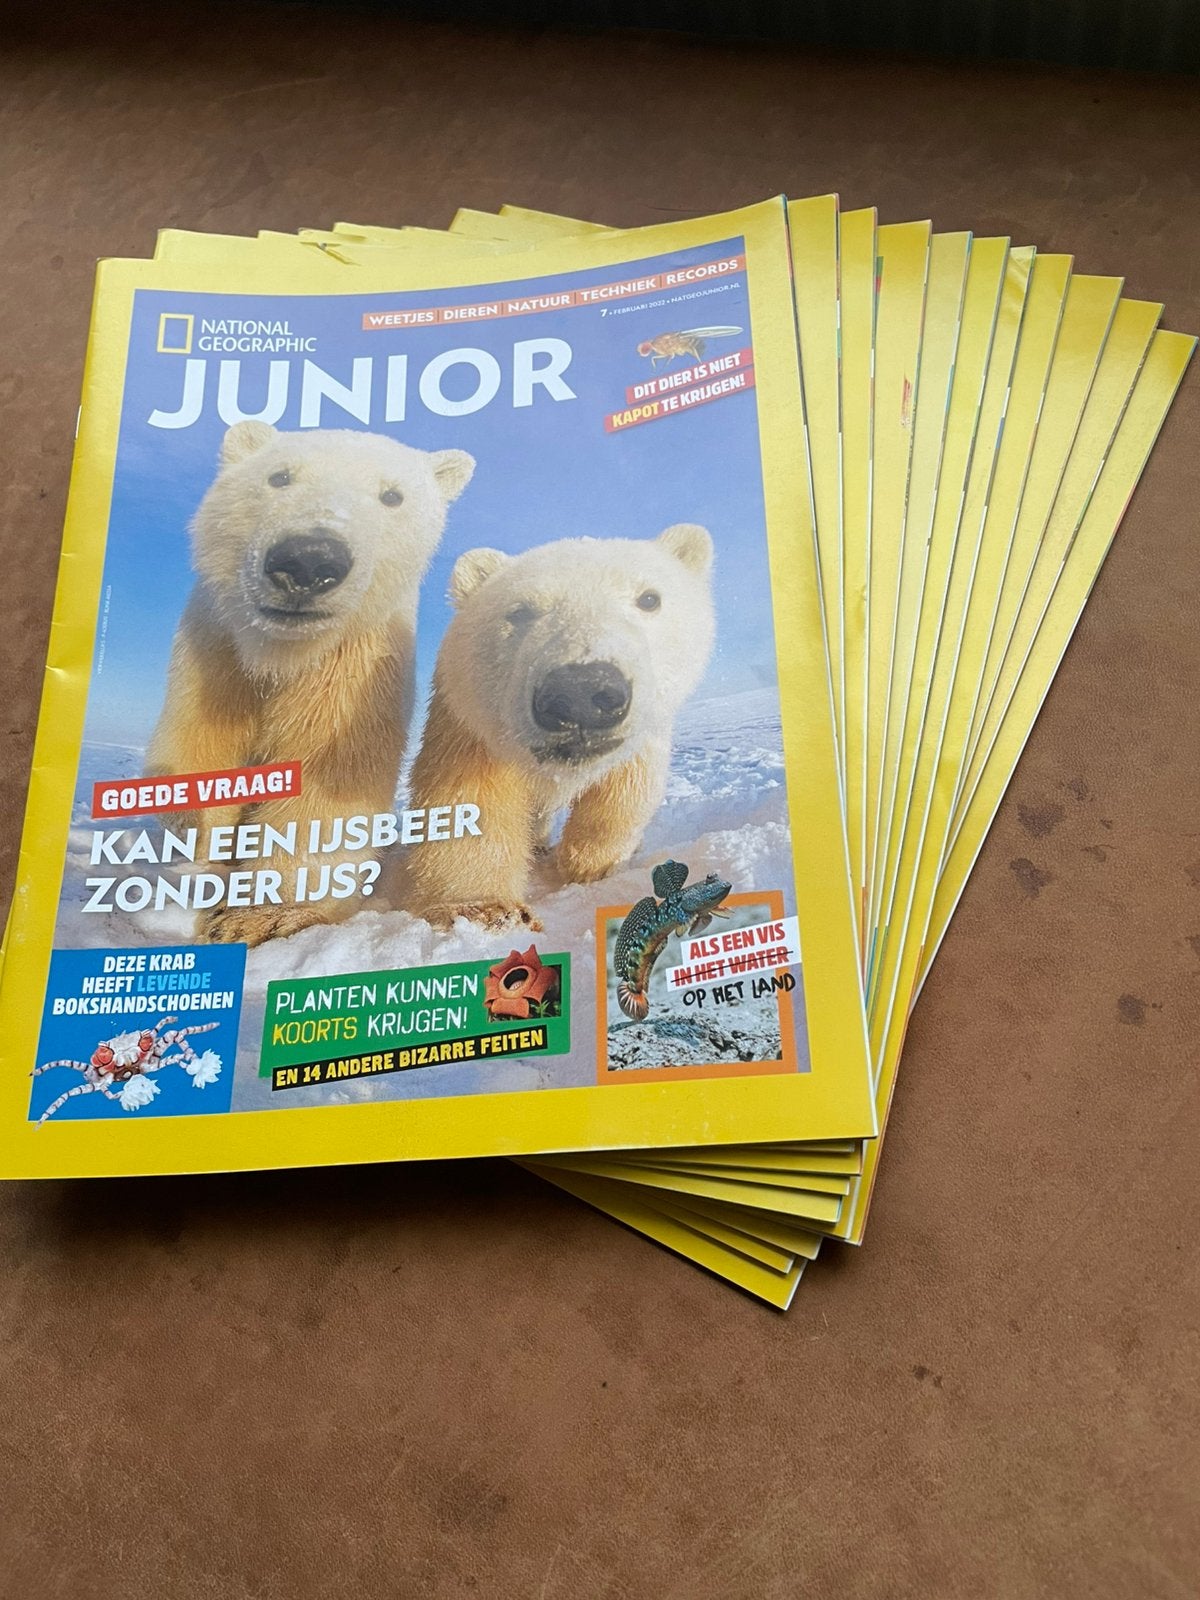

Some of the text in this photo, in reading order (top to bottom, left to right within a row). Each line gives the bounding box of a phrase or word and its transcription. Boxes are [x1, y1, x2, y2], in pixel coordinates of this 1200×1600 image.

[369, 259, 738, 326] WEETJES DIEREN NATUUR TECHNIEK RECORDS
[600, 282, 740, 317] 7 FEBRUARI 2022 NATGEOJUNIOR.NL
[198, 336, 317, 352] GEOGRAPHIC
[200, 319, 293, 336] NATIONAL
[147, 337, 578, 430] JUNIOR
[634, 353, 741, 399] DIT DIER IS NIET
[612, 373, 746, 427] KAPOT TE KRIJGEN!
[102, 769, 294, 811] GOEDE VRAAG!
[89, 803, 482, 866] KAN EEN IJSBEER
[81, 860, 381, 913] ZONDER IJS?
[689, 922, 786, 960] ALS EEN VIS
[82, 972, 212, 994] HEEFT LEVENDE
[103, 953, 196, 973] DEZE KRAB
[673, 946, 790, 987] IN HET WATER
[52, 991, 235, 1016] BOKSHANDSCHOENEN
[275, 973, 478, 1015] PLANTEN KUNNEN
[682, 973, 796, 1008] OP HET LAND
[272, 1006, 468, 1046] KOORTS KRIJGEN!
[275, 1029, 543, 1087] EN 14 ANDERE BIZARRE FEITEN
